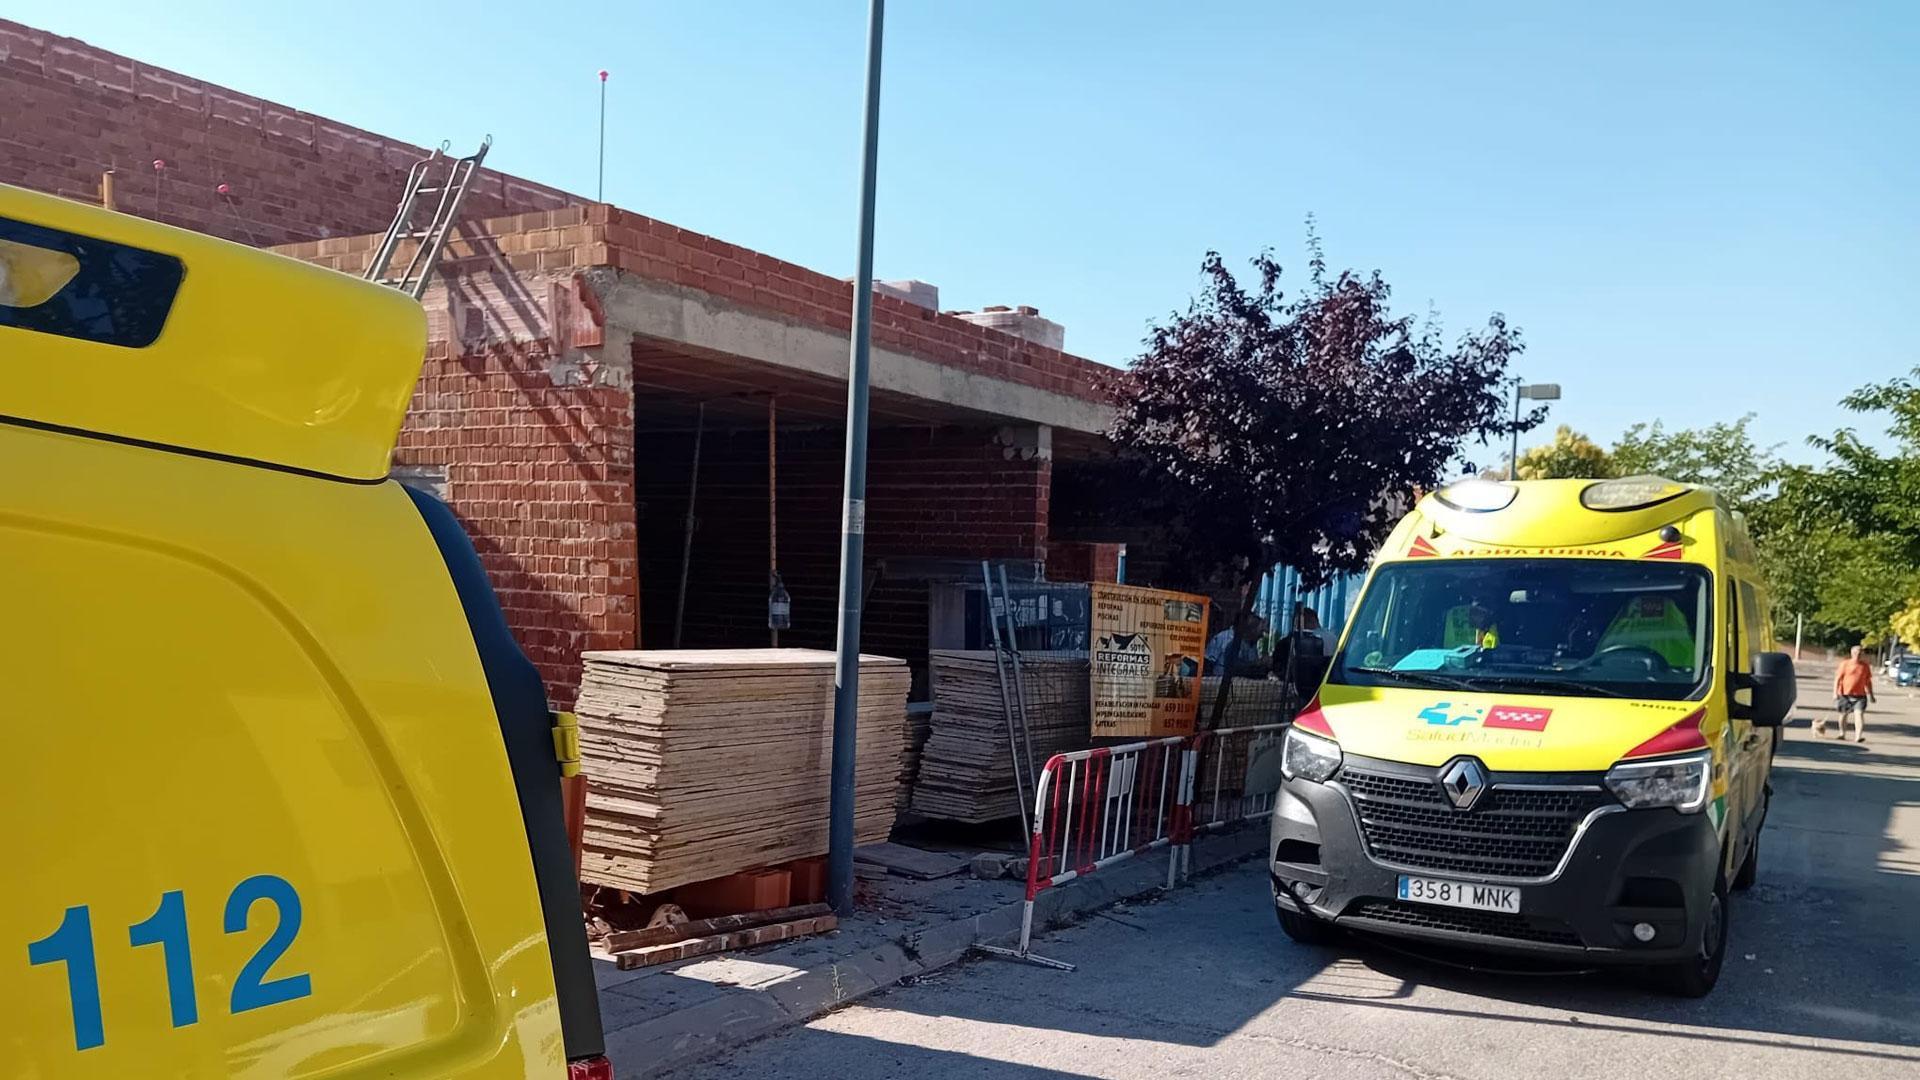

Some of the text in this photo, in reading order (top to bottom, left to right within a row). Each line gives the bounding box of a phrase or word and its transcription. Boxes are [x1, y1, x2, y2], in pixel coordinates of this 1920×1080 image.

[1097, 652, 1149, 664] REFORMAS
[1096, 662, 1149, 677] INTEGRALES
[1412, 880, 1515, 909] 3581 MNK
[28, 874, 312, 1051] 112
